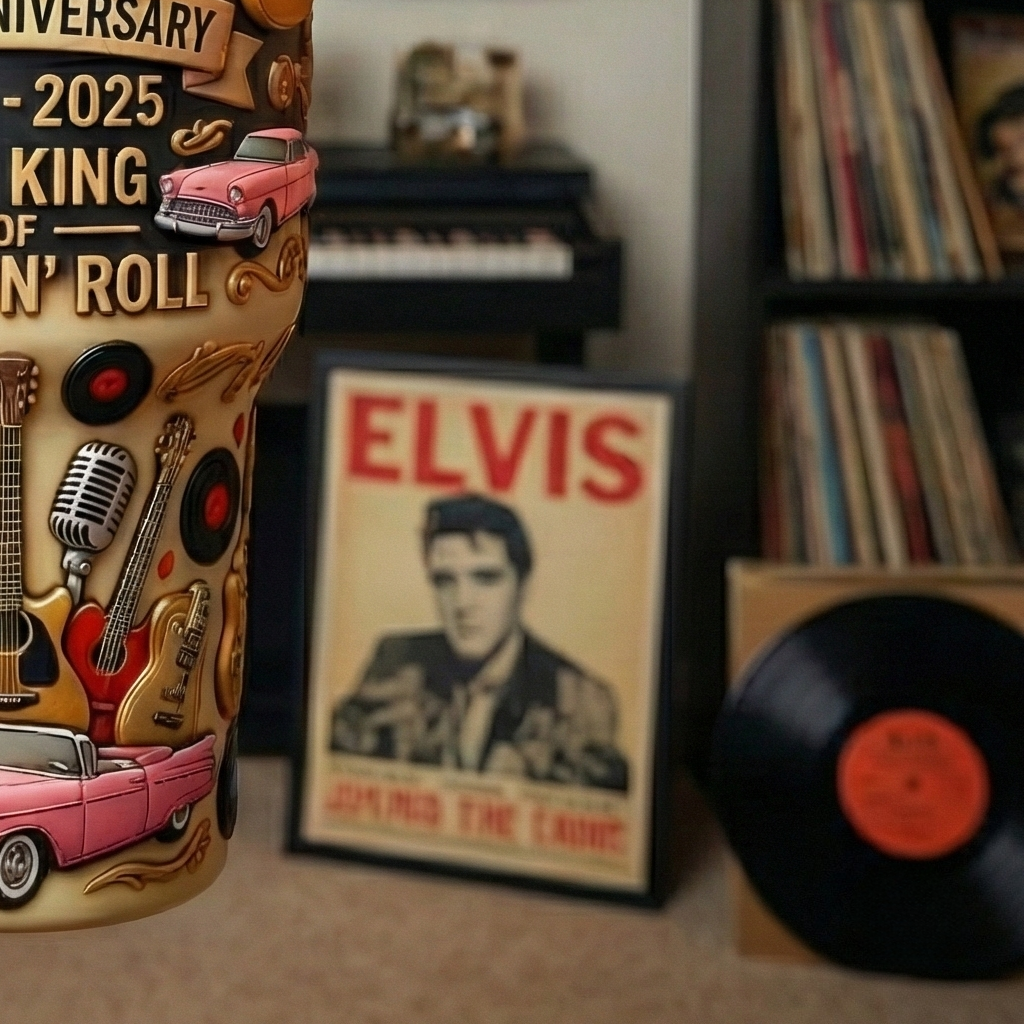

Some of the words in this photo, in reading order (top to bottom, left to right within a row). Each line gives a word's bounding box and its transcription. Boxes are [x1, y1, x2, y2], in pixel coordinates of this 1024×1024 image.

[32, 75, 164, 127] 2025
[11, 147, 148, 206] KING
[77, 254, 209, 314] ROLL
[347, 394, 646, 505] ELVIS
